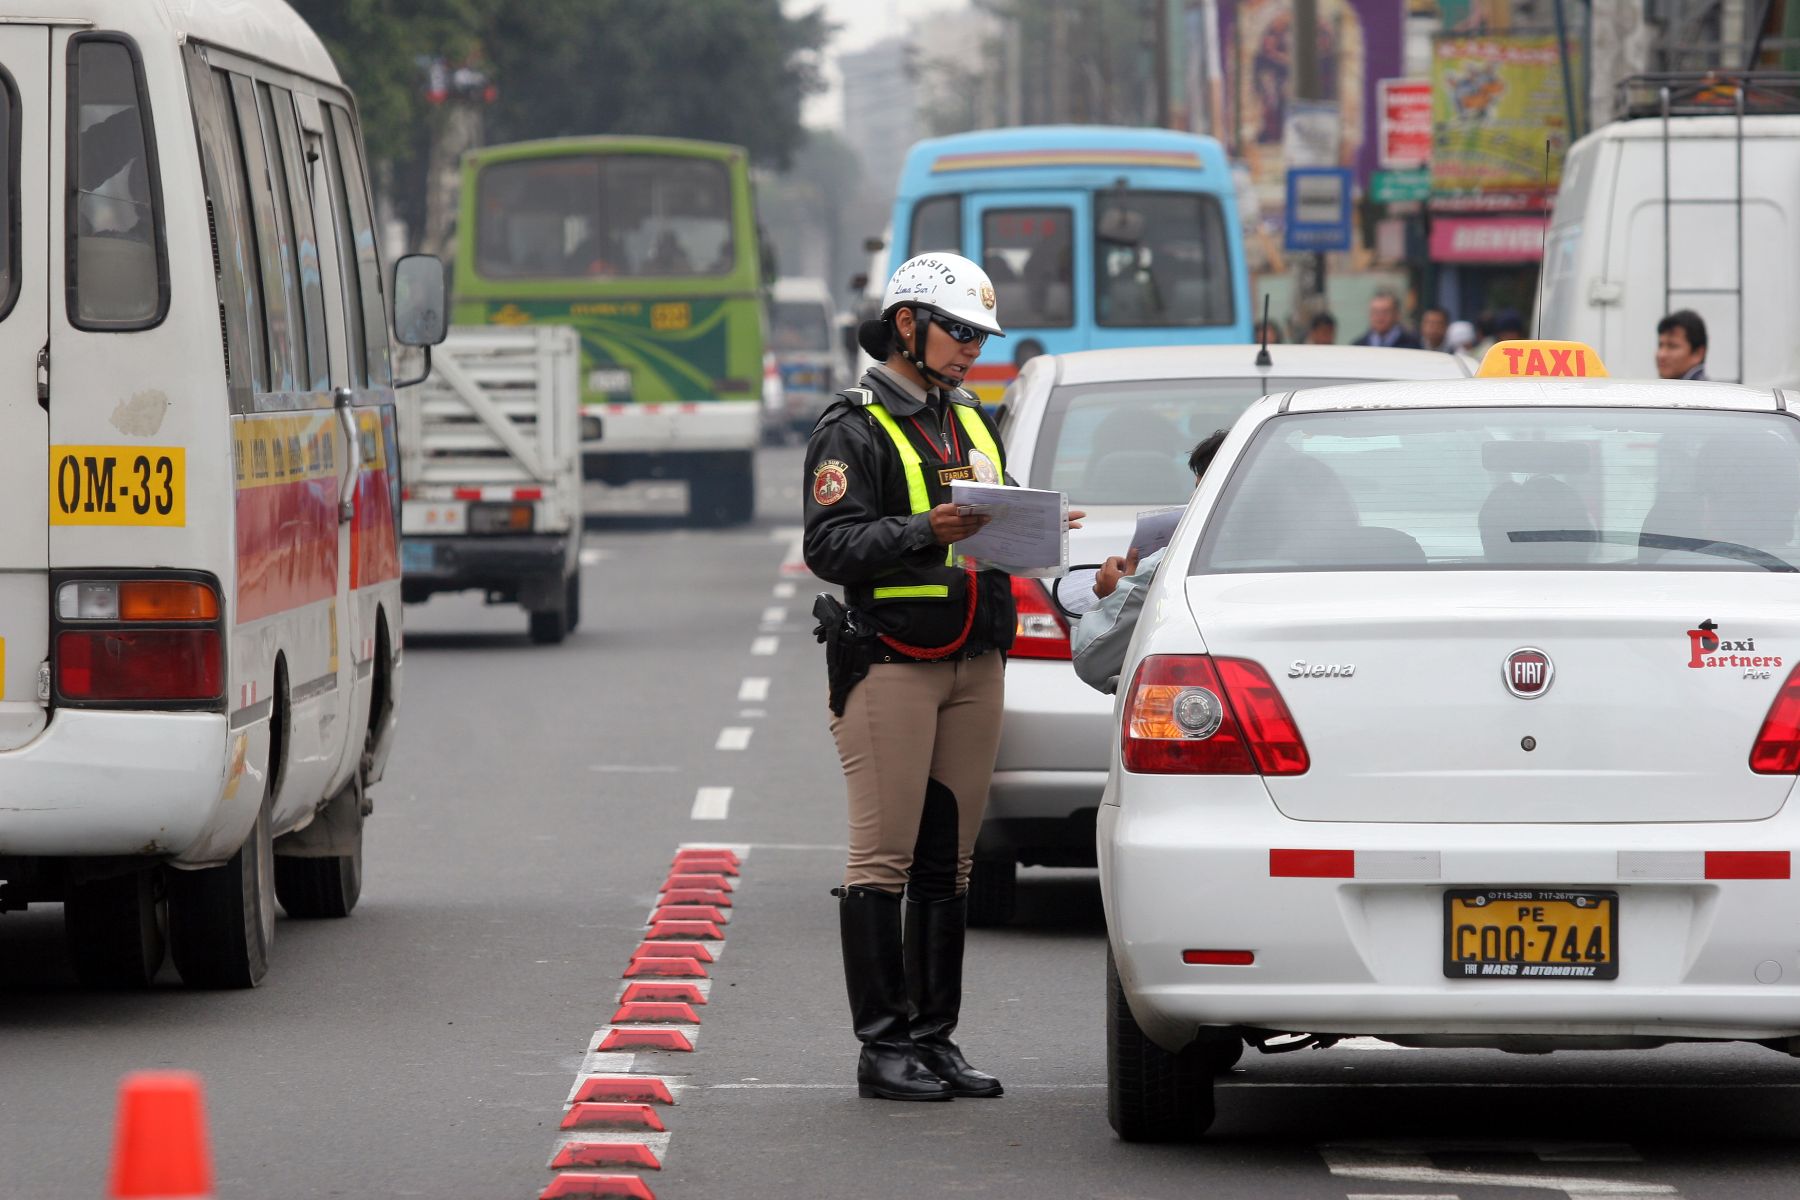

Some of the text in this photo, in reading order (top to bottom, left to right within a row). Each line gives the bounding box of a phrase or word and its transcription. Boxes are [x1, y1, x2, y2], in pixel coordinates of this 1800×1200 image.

[1502, 348, 1586, 377] TAXI
[58, 454, 173, 515] OM-33
[944, 470, 969, 481] FARIAS
[1287, 659, 1356, 679] Siena
[1514, 662, 1543, 684] FIAT
[1518, 907, 1544, 922] PE
[1464, 964, 1597, 976] FIAT MASS AUTOMOTRIZ
